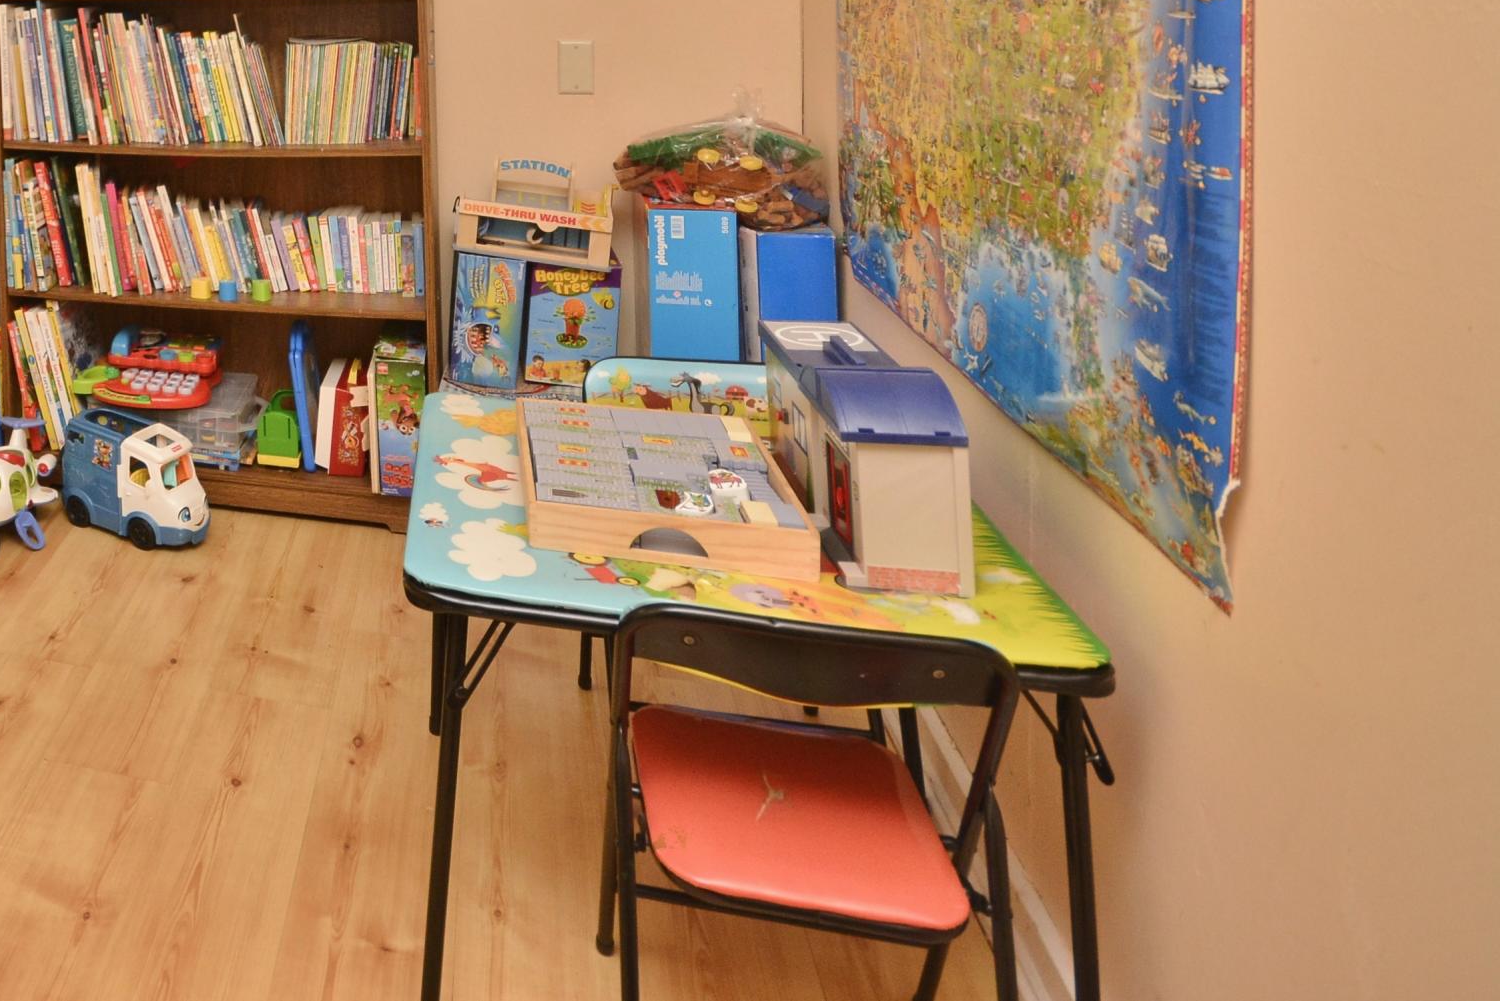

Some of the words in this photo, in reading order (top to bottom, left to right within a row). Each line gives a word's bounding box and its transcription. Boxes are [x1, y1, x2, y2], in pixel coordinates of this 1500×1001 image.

[500, 159, 570, 178] STATION
[464, 203, 536, 220] DRIVE-THRU
[539, 213, 576, 226] WASH
[654, 215, 668, 266] playmobil
[534, 269, 605, 284] Honeybee
[553, 281, 590, 295] Tree
